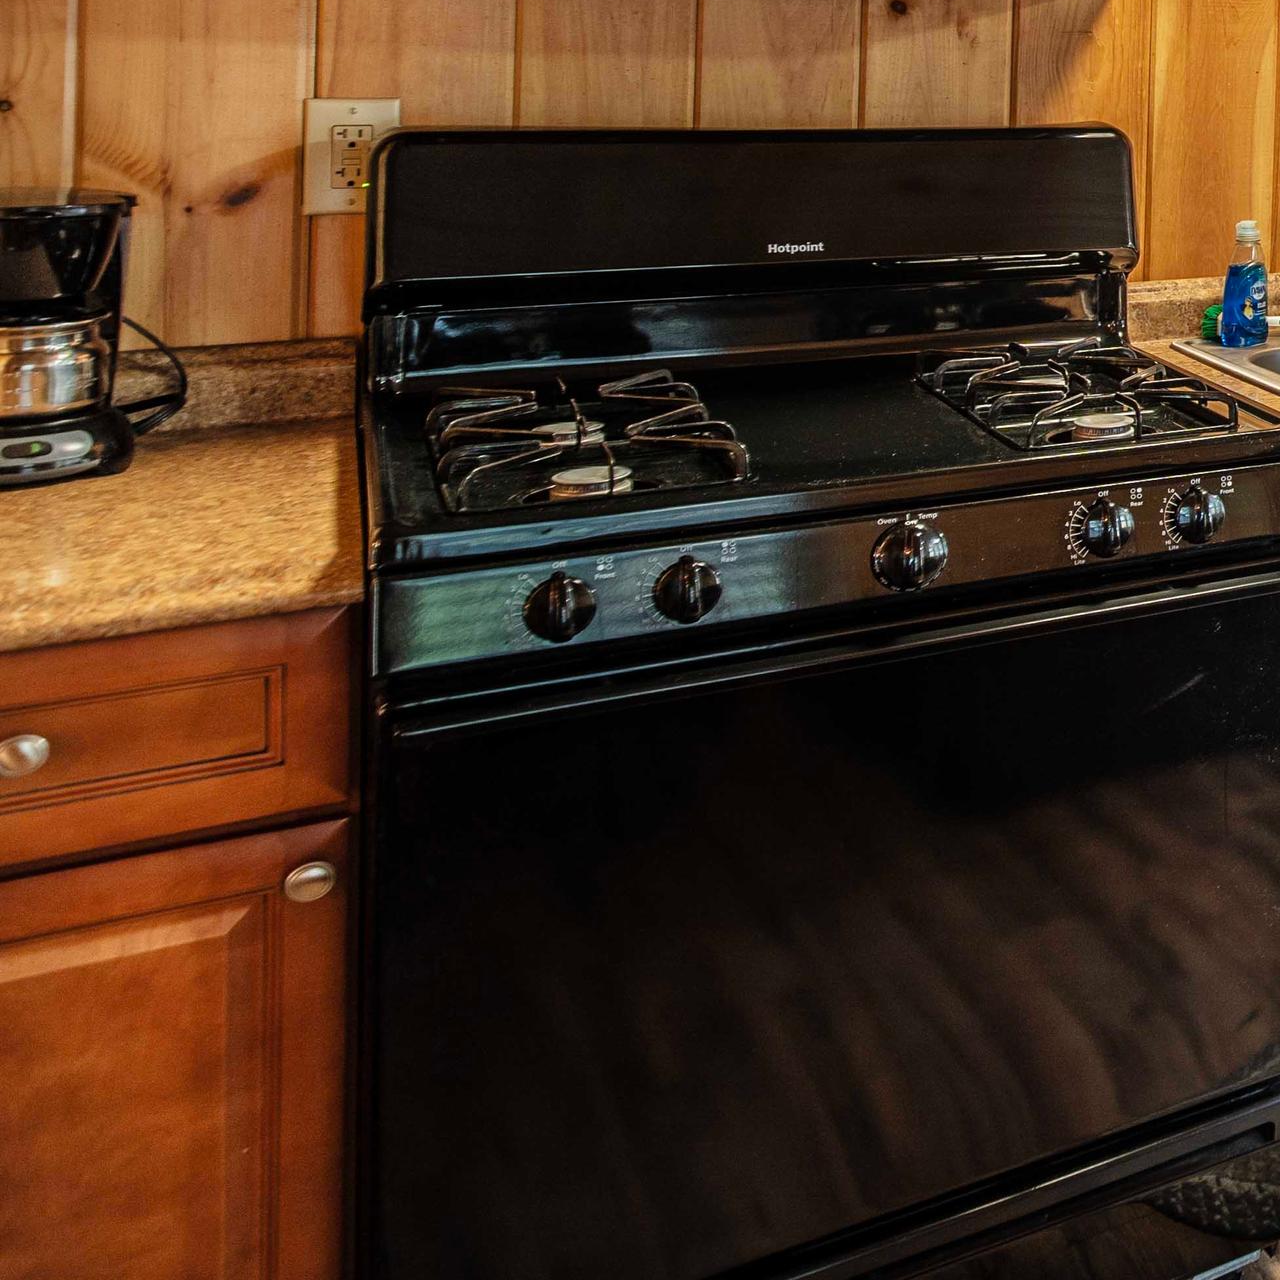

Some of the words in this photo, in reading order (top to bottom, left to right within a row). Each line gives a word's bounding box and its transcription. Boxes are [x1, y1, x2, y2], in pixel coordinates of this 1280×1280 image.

[768, 241, 825, 255] Hotpoint
[1097, 490, 1109, 498] Off
[918, 512, 938, 520] Temp
